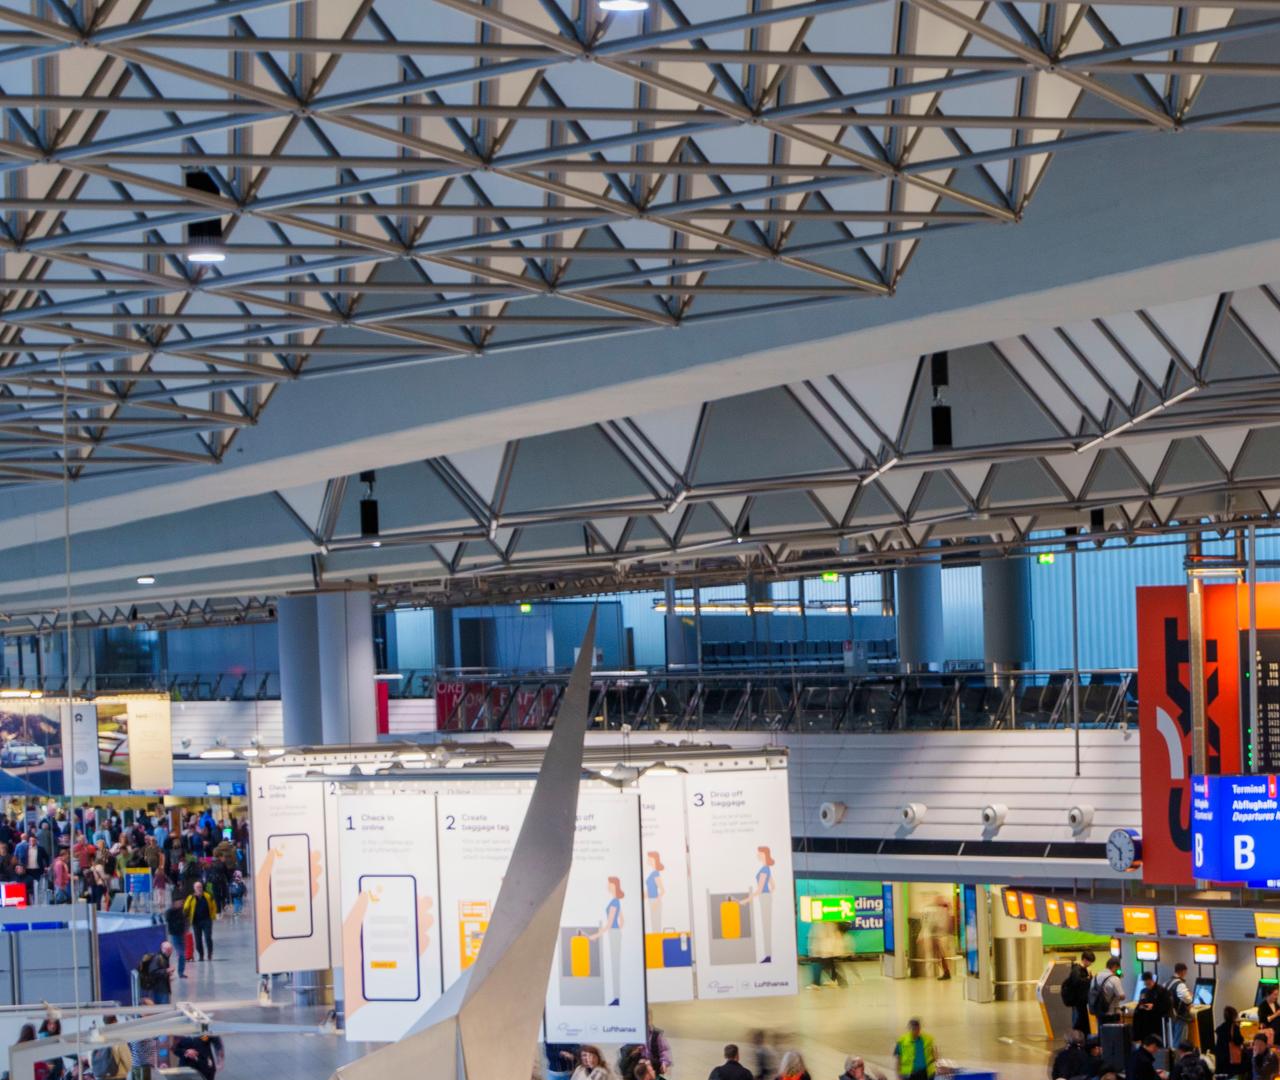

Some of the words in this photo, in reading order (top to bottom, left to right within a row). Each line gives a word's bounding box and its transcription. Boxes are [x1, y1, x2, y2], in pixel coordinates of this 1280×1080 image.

[257, 786, 265, 799] 1
[1232, 784, 1266, 794] Terminal
[693, 792, 705, 807] 3
[1232, 800, 1278, 811] Abflughalle
[446, 815, 456, 831] 2
[1232, 811, 1274, 822] Departures
[346, 816, 356, 831] 1
[461, 824, 495, 833] baggage
[1195, 833, 1204, 868] B
[1234, 834, 1256, 870] B
[602, 1025, 636, 1033] Lufthansa
